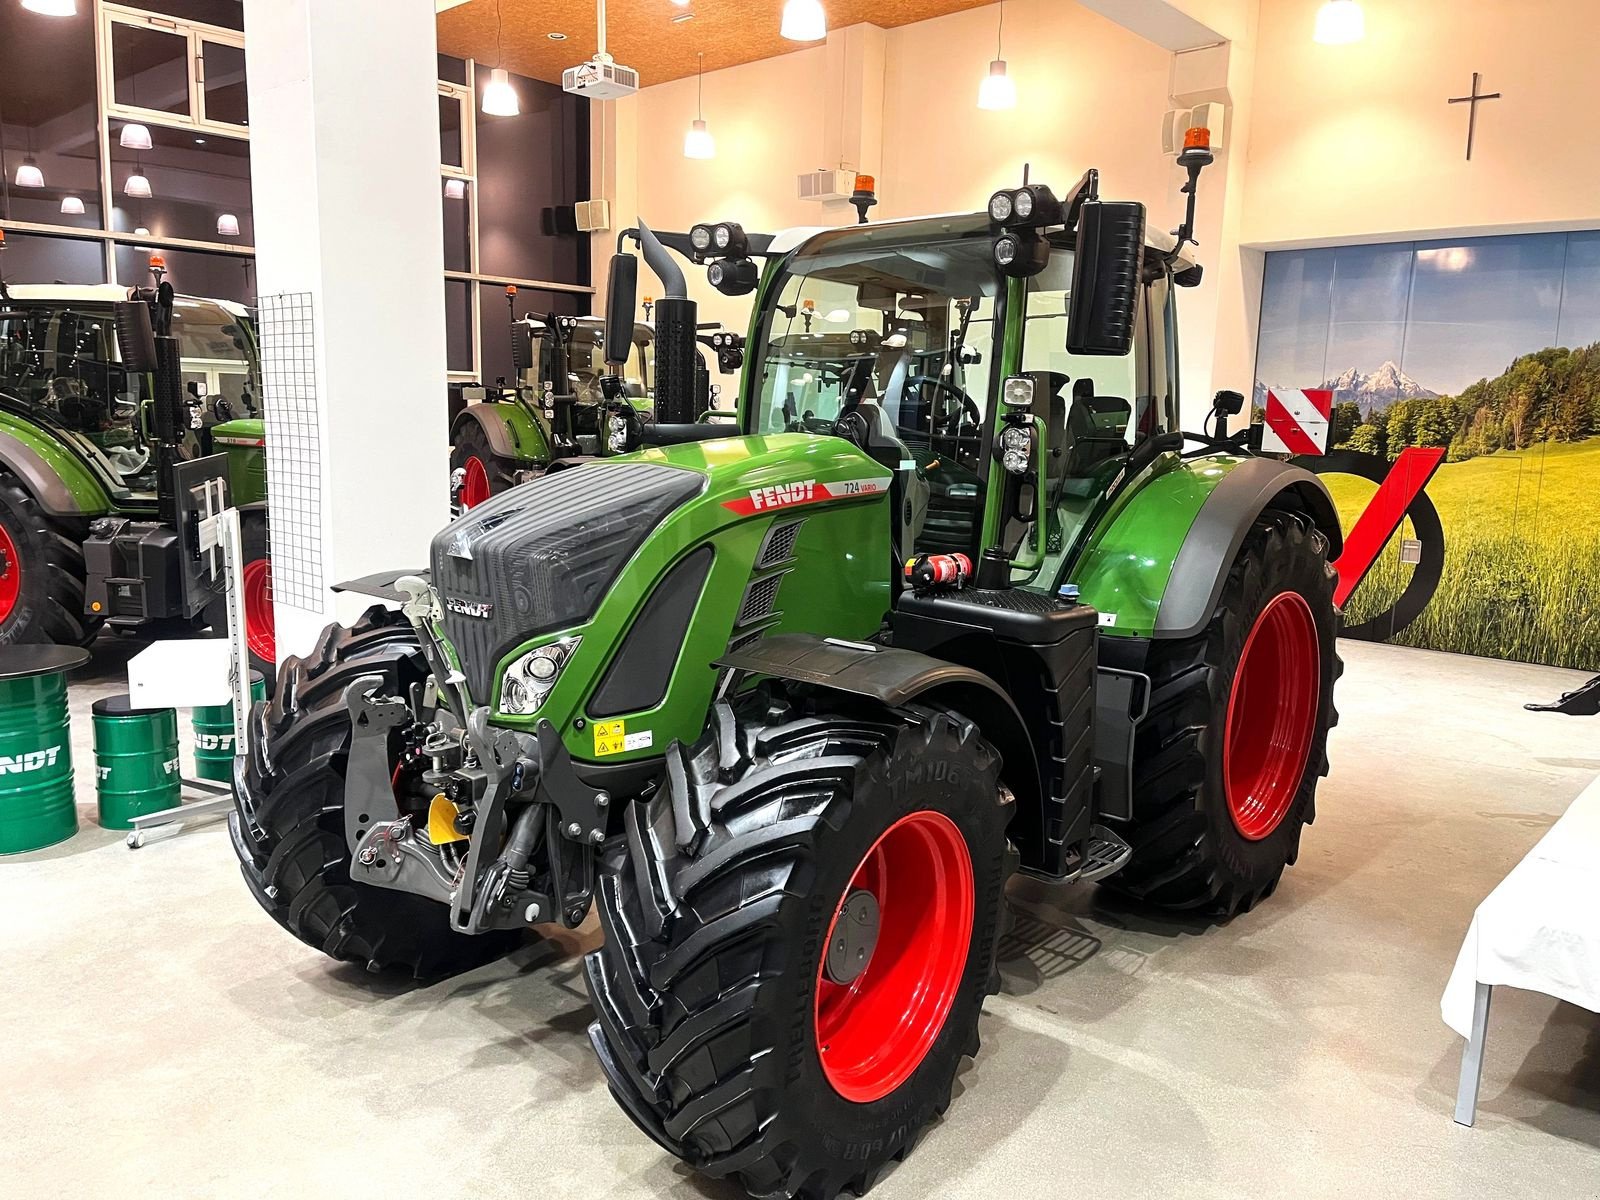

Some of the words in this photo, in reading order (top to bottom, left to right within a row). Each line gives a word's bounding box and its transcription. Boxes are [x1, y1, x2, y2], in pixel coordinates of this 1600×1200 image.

[749, 479, 816, 510] FENDT
[844, 482, 859, 494] 724
[860, 483, 877, 492] VARIO
[446, 597, 493, 619] FENDT
[193, 733, 235, 750] NDT
[0, 744, 61, 775] NDT
